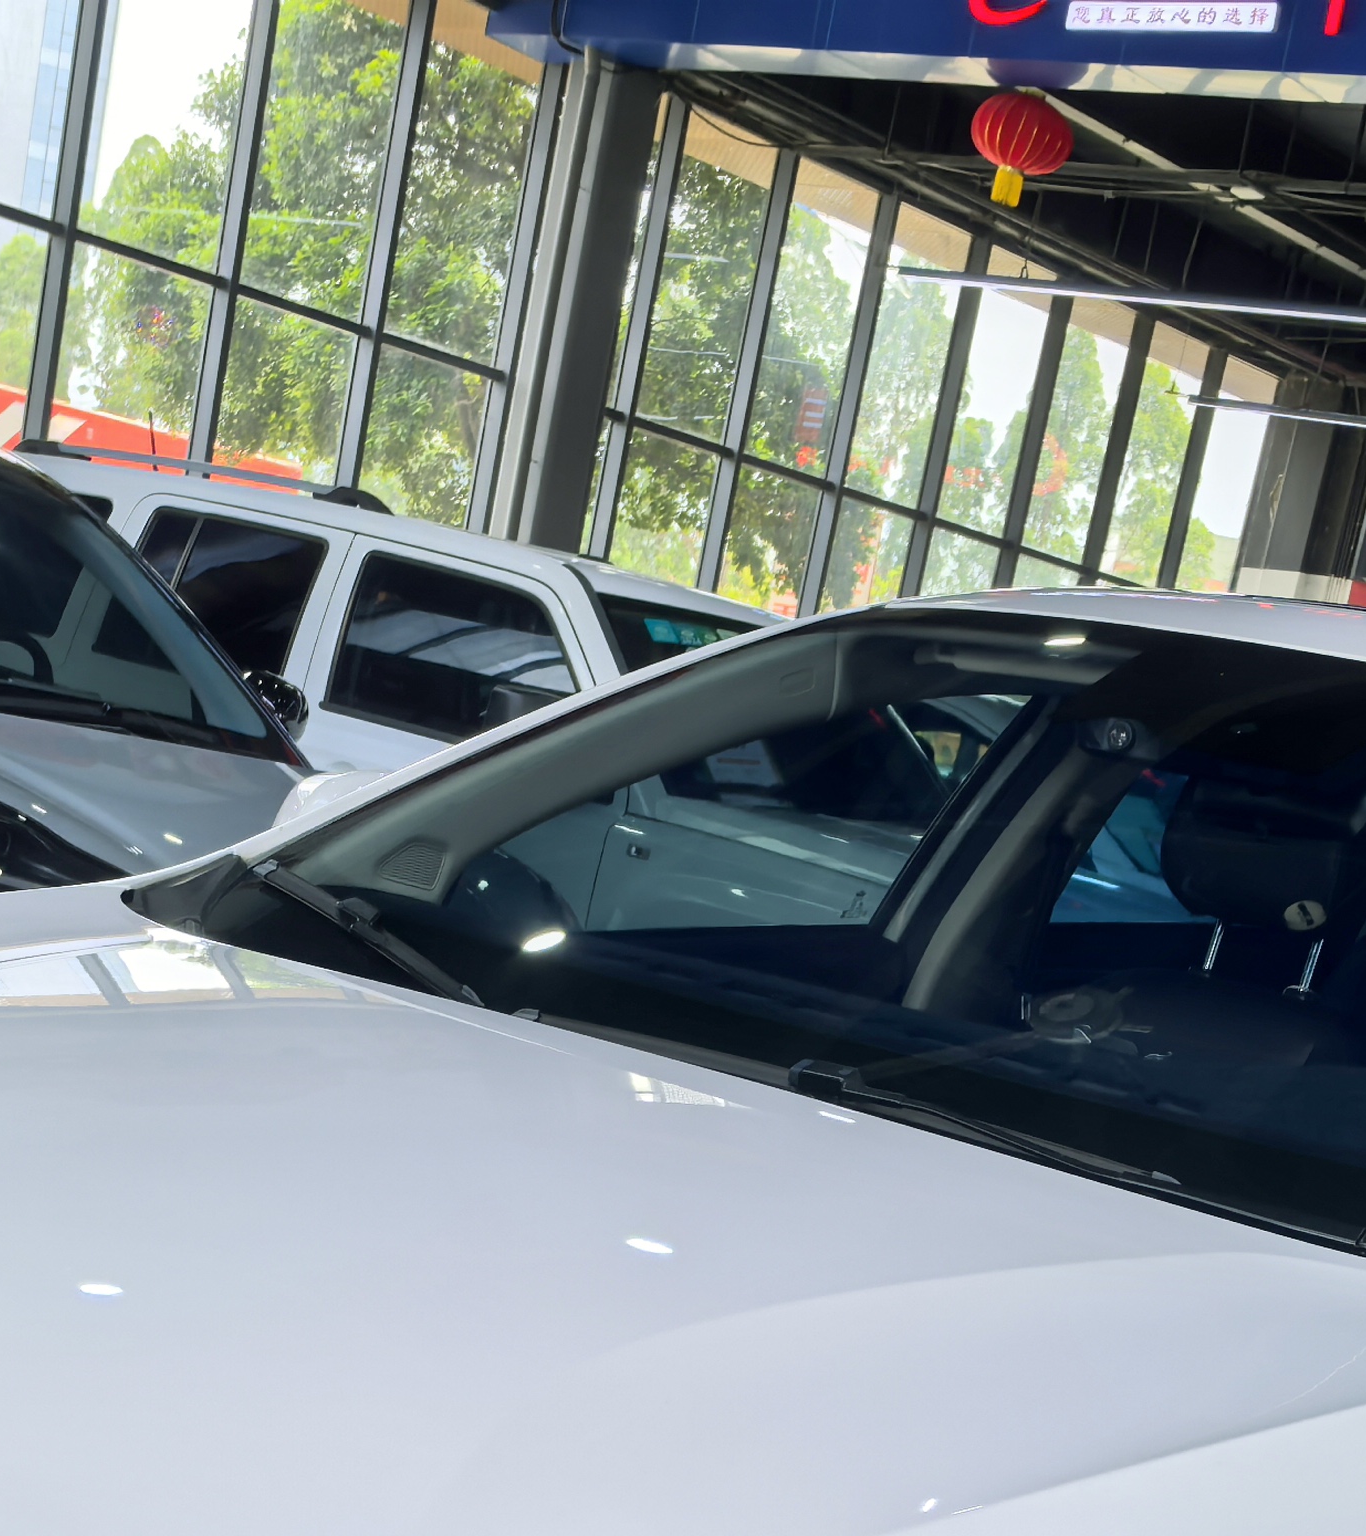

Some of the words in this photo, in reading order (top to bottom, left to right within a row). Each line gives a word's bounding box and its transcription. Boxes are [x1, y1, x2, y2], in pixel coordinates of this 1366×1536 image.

[1072, 5, 1271, 26] 您真正放心的选择
